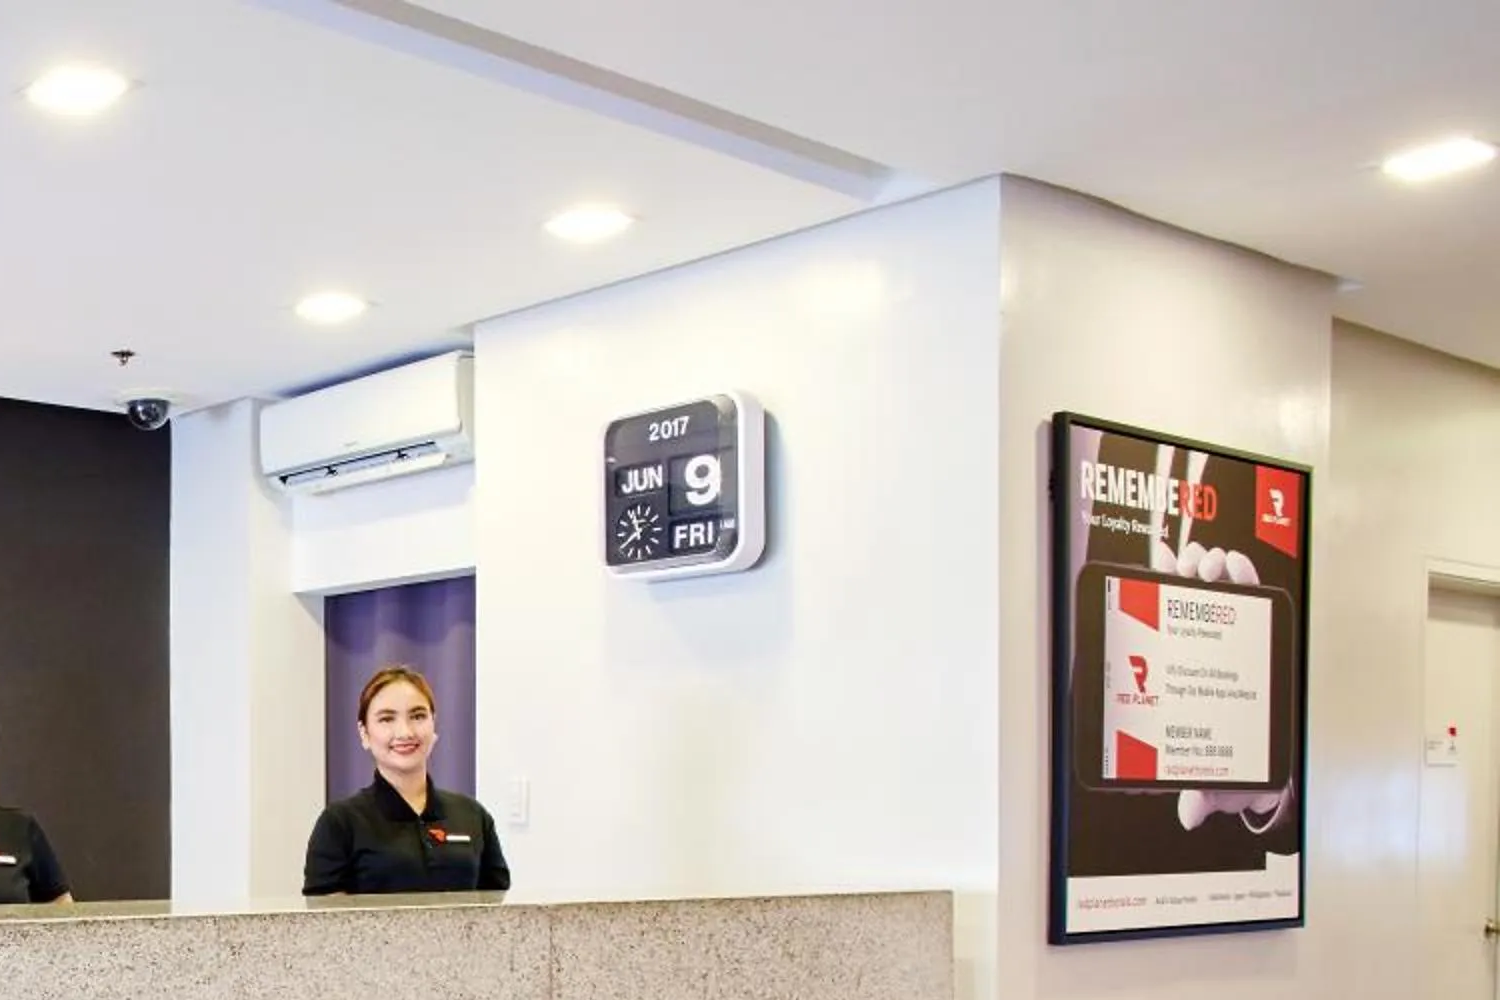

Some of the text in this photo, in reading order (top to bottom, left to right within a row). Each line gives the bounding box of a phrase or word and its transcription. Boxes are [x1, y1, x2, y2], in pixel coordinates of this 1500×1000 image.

[648, 416, 690, 442] 2017
[621, 464, 664, 494] JUN
[685, 454, 721, 506] 9
[673, 521, 715, 549] FRI
